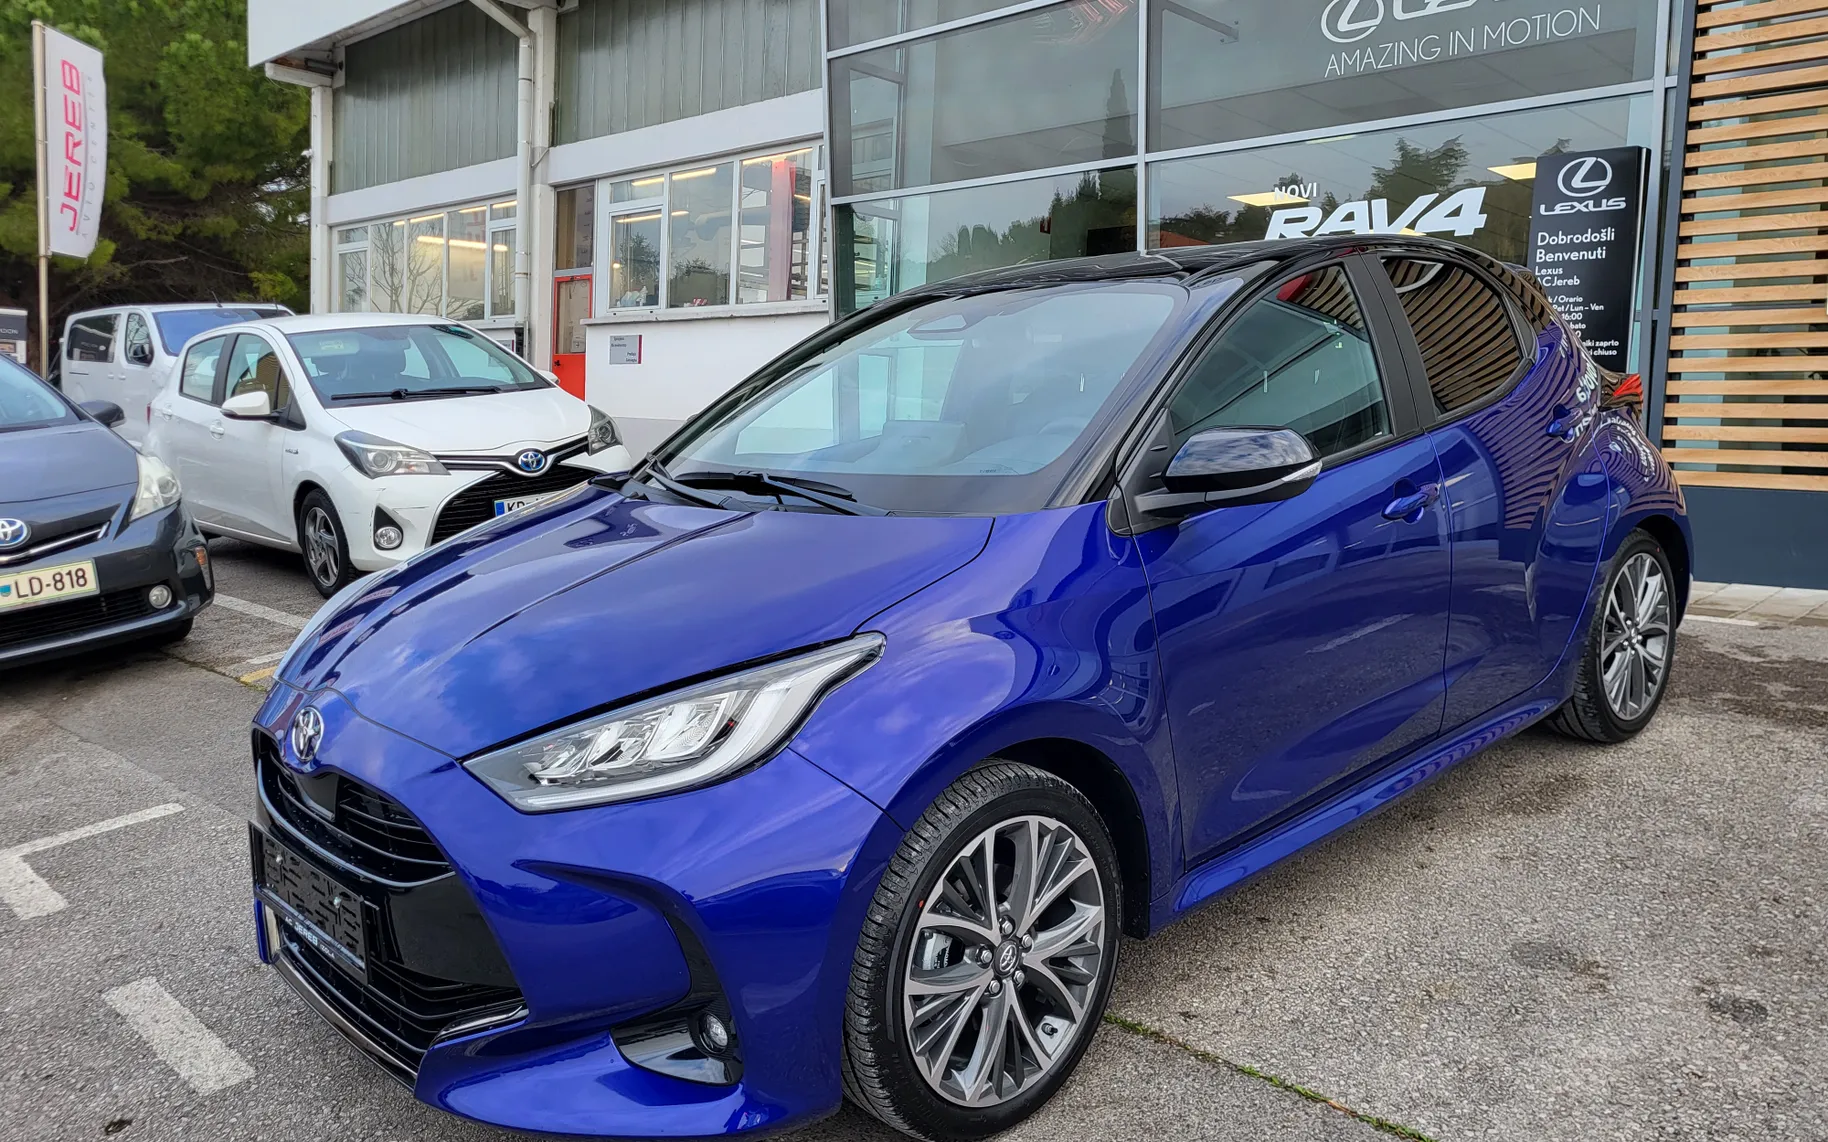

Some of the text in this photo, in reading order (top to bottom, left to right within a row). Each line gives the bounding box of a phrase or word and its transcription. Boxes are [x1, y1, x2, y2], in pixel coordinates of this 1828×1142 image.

[1324, 34, 1442, 78] AMAZING
[1449, 28, 1475, 56] IN
[1483, 4, 1601, 50] MOTION
[60, 59, 83, 232] JEREB
[1273, 182, 1318, 201] NOVI
[1264, 186, 1488, 240] RAV4
[1539, 197, 1627, 216] LEXUS
[1537, 226, 1615, 246] Dobrodošli
[1535, 246, 1607, 263] Benvenuti
[1535, 265, 1563, 276] Lexus
[1558, 295, 1584, 303] Orario
[14, 567, 88, 599] LD-818
